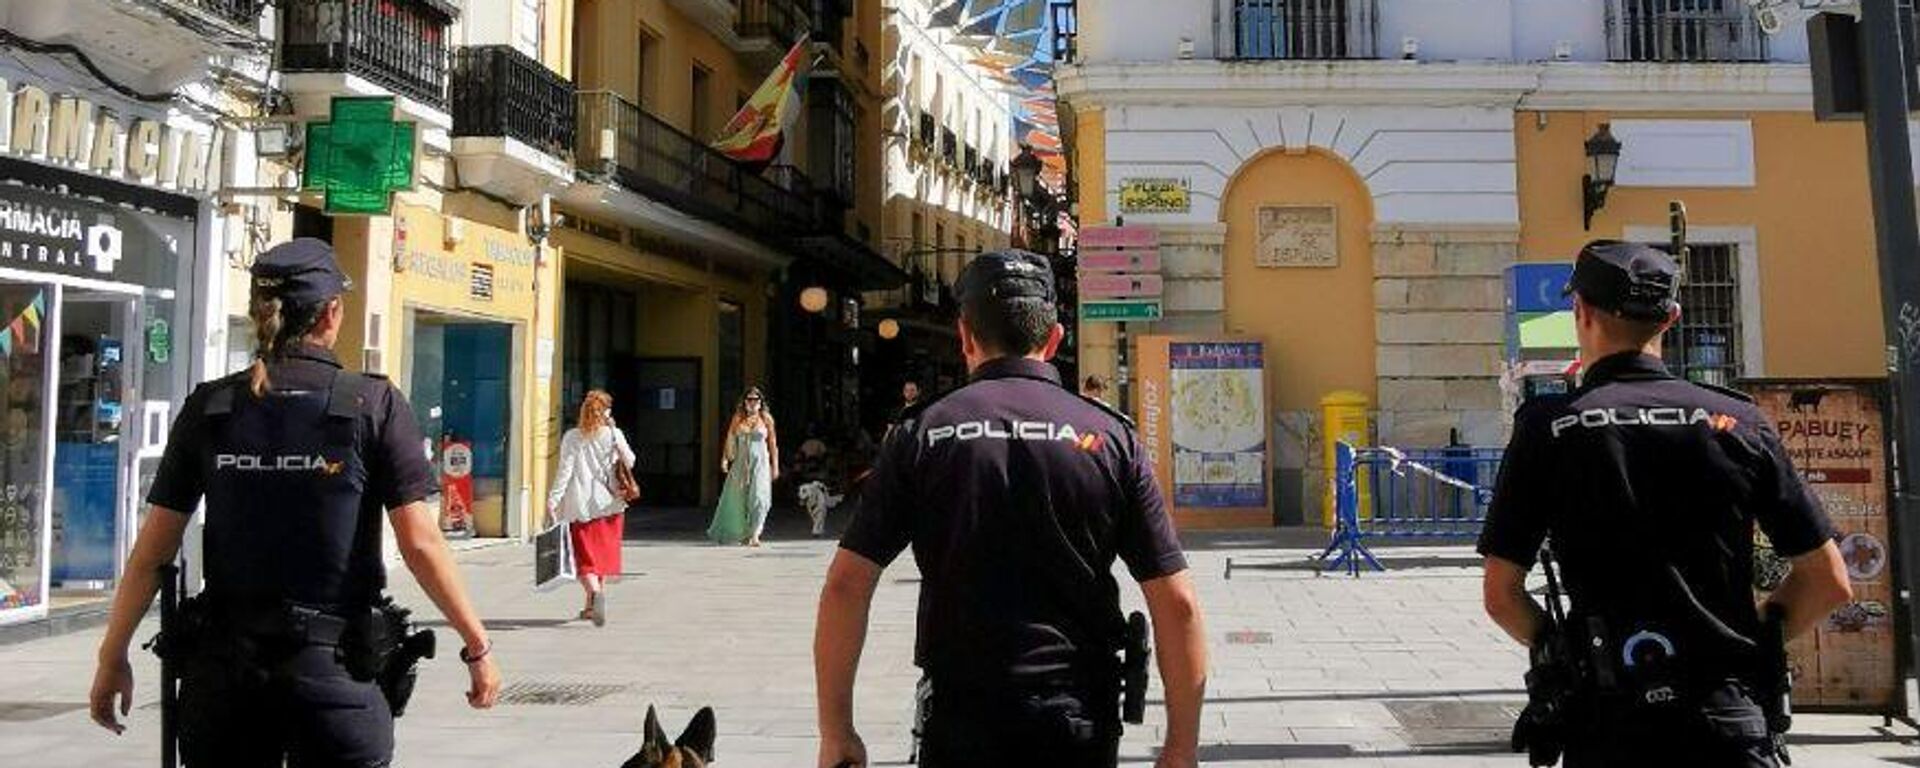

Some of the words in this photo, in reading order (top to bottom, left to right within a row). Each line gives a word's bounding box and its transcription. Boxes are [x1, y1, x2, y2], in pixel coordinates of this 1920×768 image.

[0, 76, 214, 191] RMACIA
[929, 419, 1080, 448] POLICIA
[1551, 407, 1714, 438] POLICIA
[216, 453, 329, 471] POLICIA
